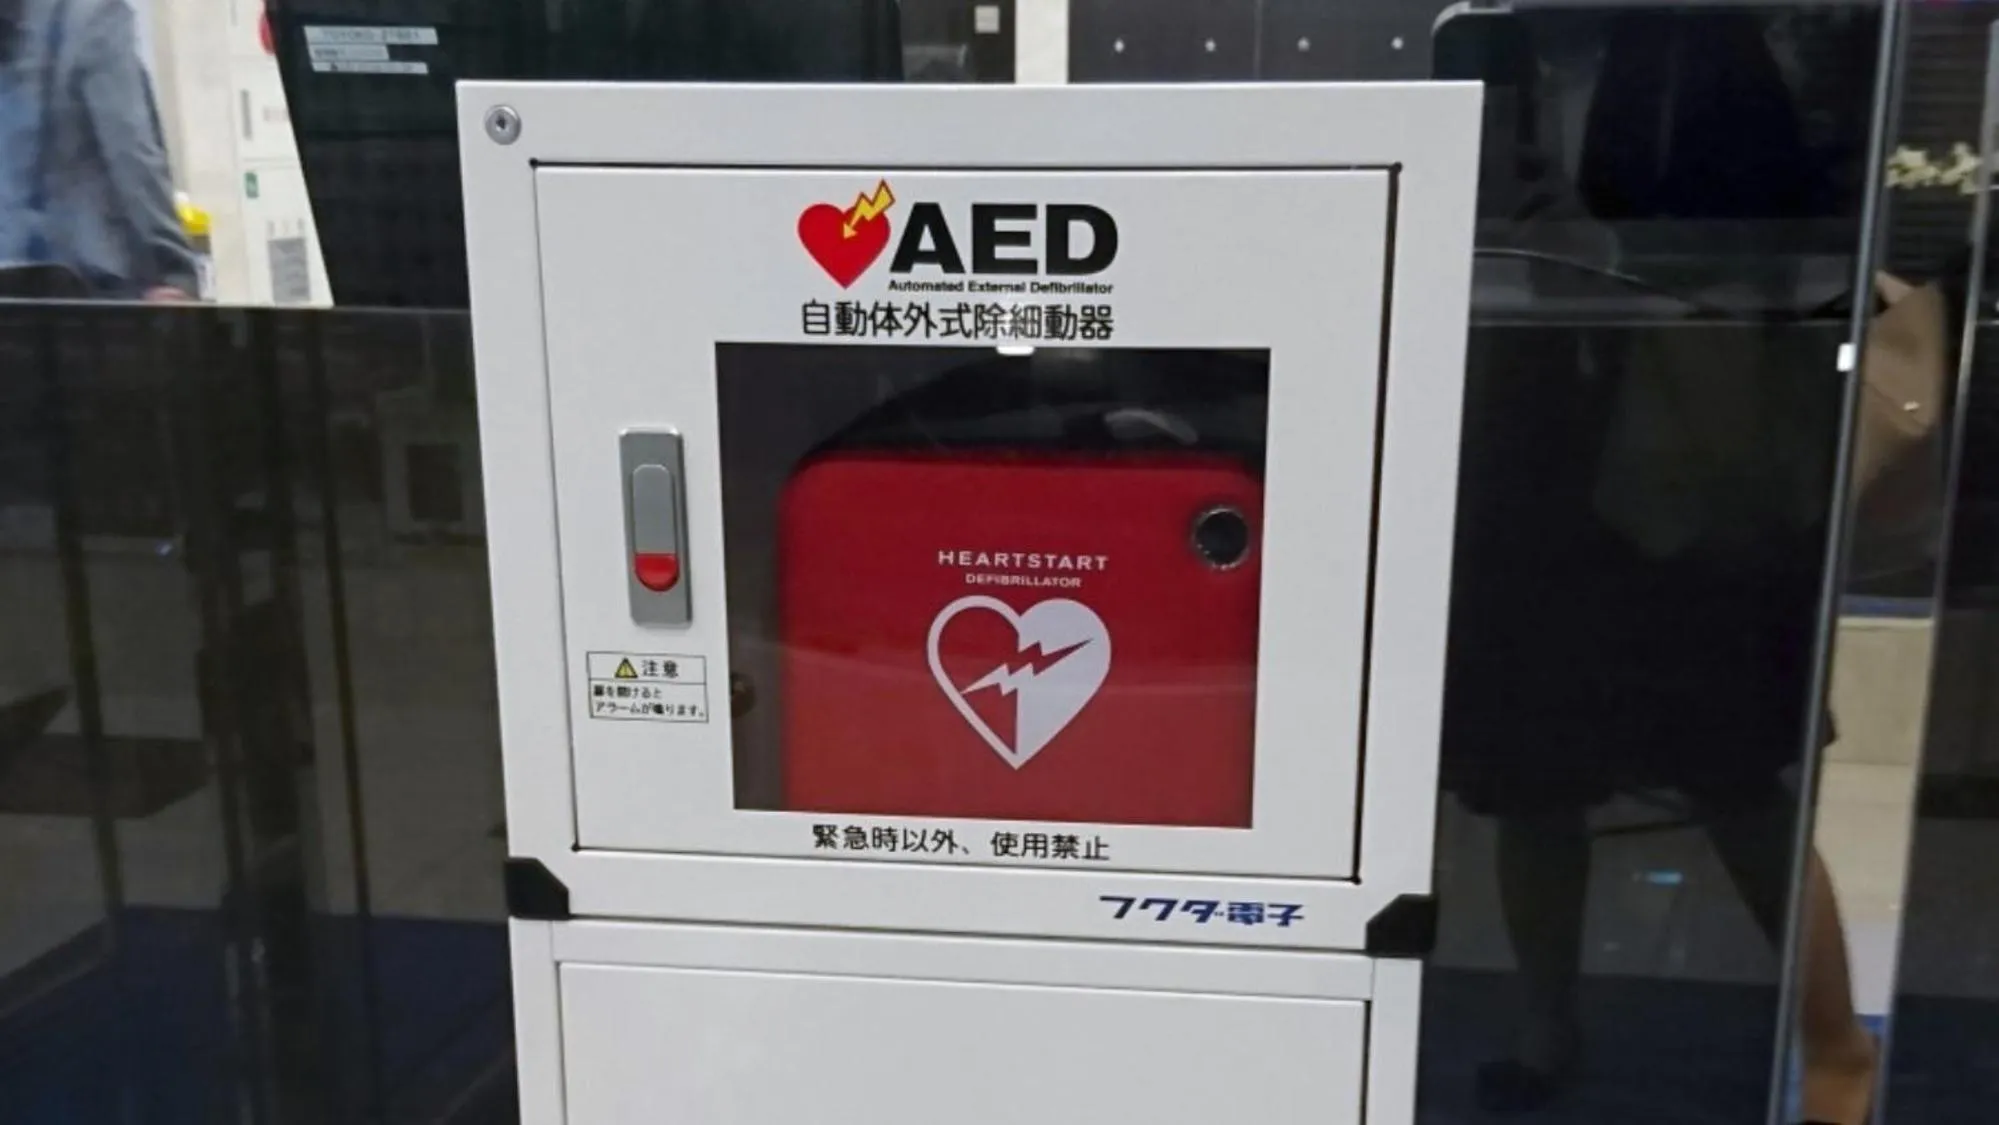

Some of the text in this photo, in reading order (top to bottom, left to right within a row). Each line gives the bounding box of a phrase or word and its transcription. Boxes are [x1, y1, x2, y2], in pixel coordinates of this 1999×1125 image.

[889, 201, 1119, 277] AED
[888, 279, 1114, 295] Automated External Defibrillator
[801, 299, 1115, 341] 自動体外式除細動器
[938, 550, 1109, 571] HEARTSTART
[965, 573, 1082, 588] DEFIBRILLATOR
[812, 823, 1111, 862] 緊急時以外、使用禁止
[1099, 895, 1305, 928] フクダ電子
